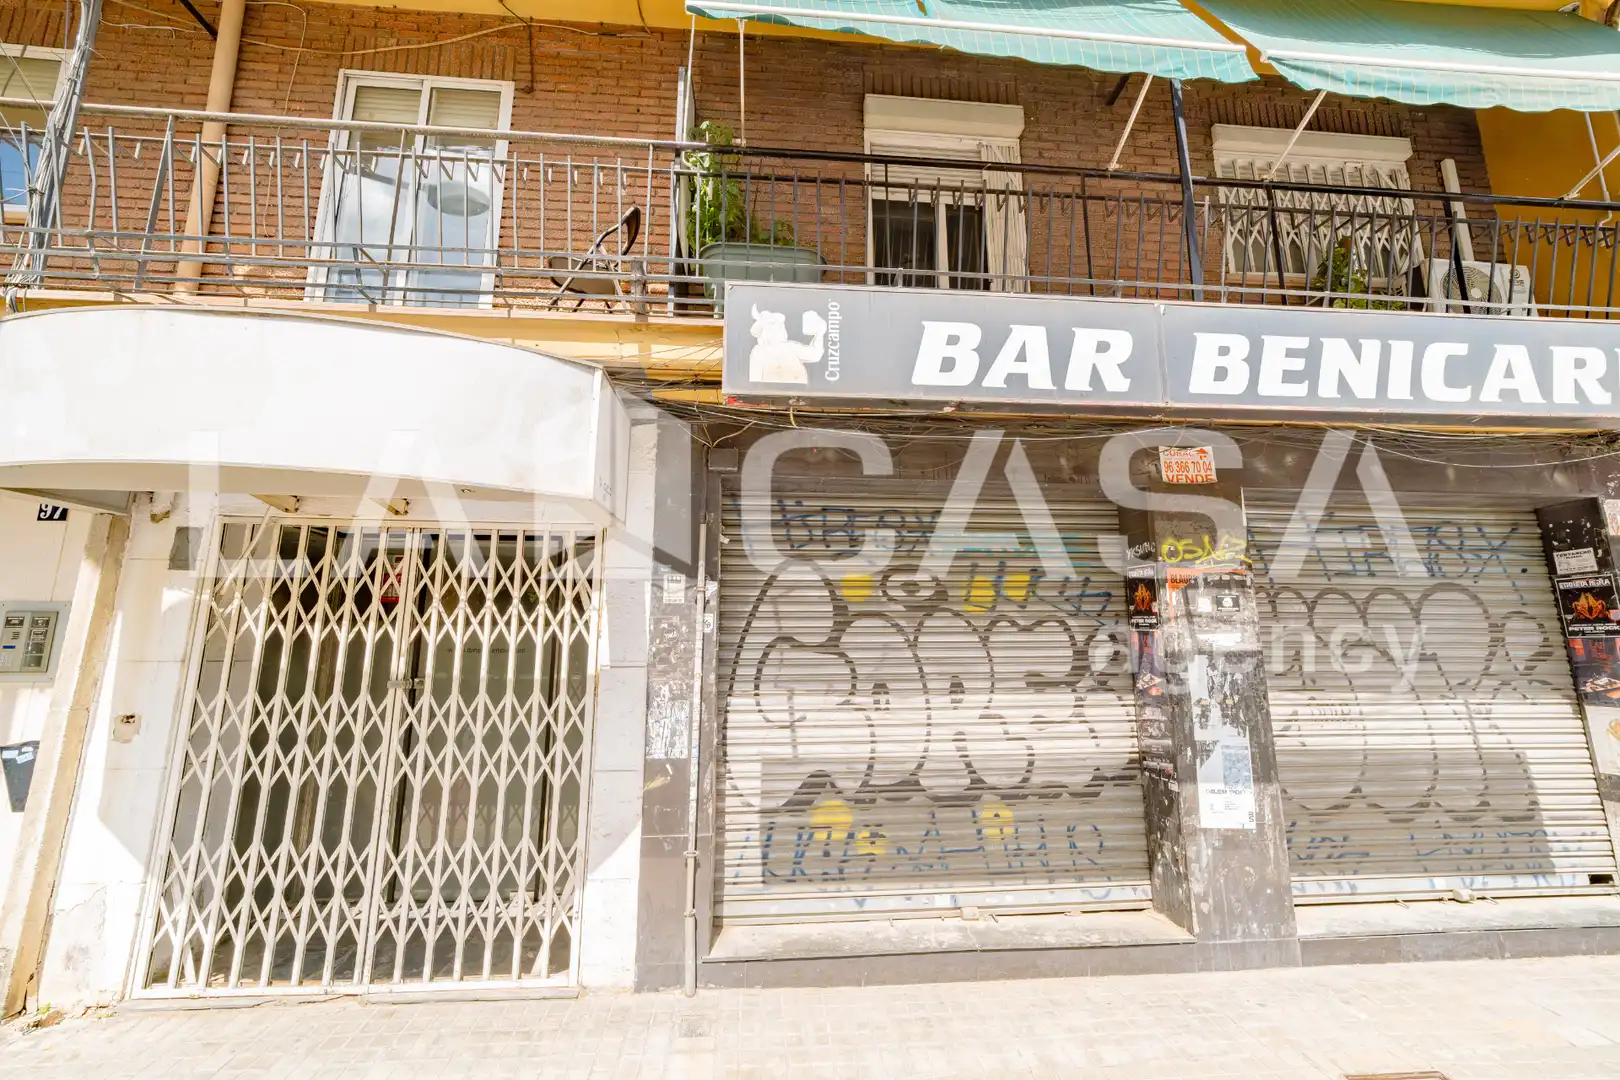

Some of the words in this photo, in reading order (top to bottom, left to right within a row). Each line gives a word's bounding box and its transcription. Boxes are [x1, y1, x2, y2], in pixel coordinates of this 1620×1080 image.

[825, 301, 842, 381] Cruzcampo
[911, 320, 1133, 393] BAR
[1188, 332, 1620, 405] BENICAR
[1163, 460, 1175, 473] 96
[1175, 460, 1190, 473] 366
[1191, 460, 1201, 473] 70
[1202, 460, 1213, 473] 04
[1165, 473, 1214, 484] VENDE
[40, 503, 64, 519] 97
